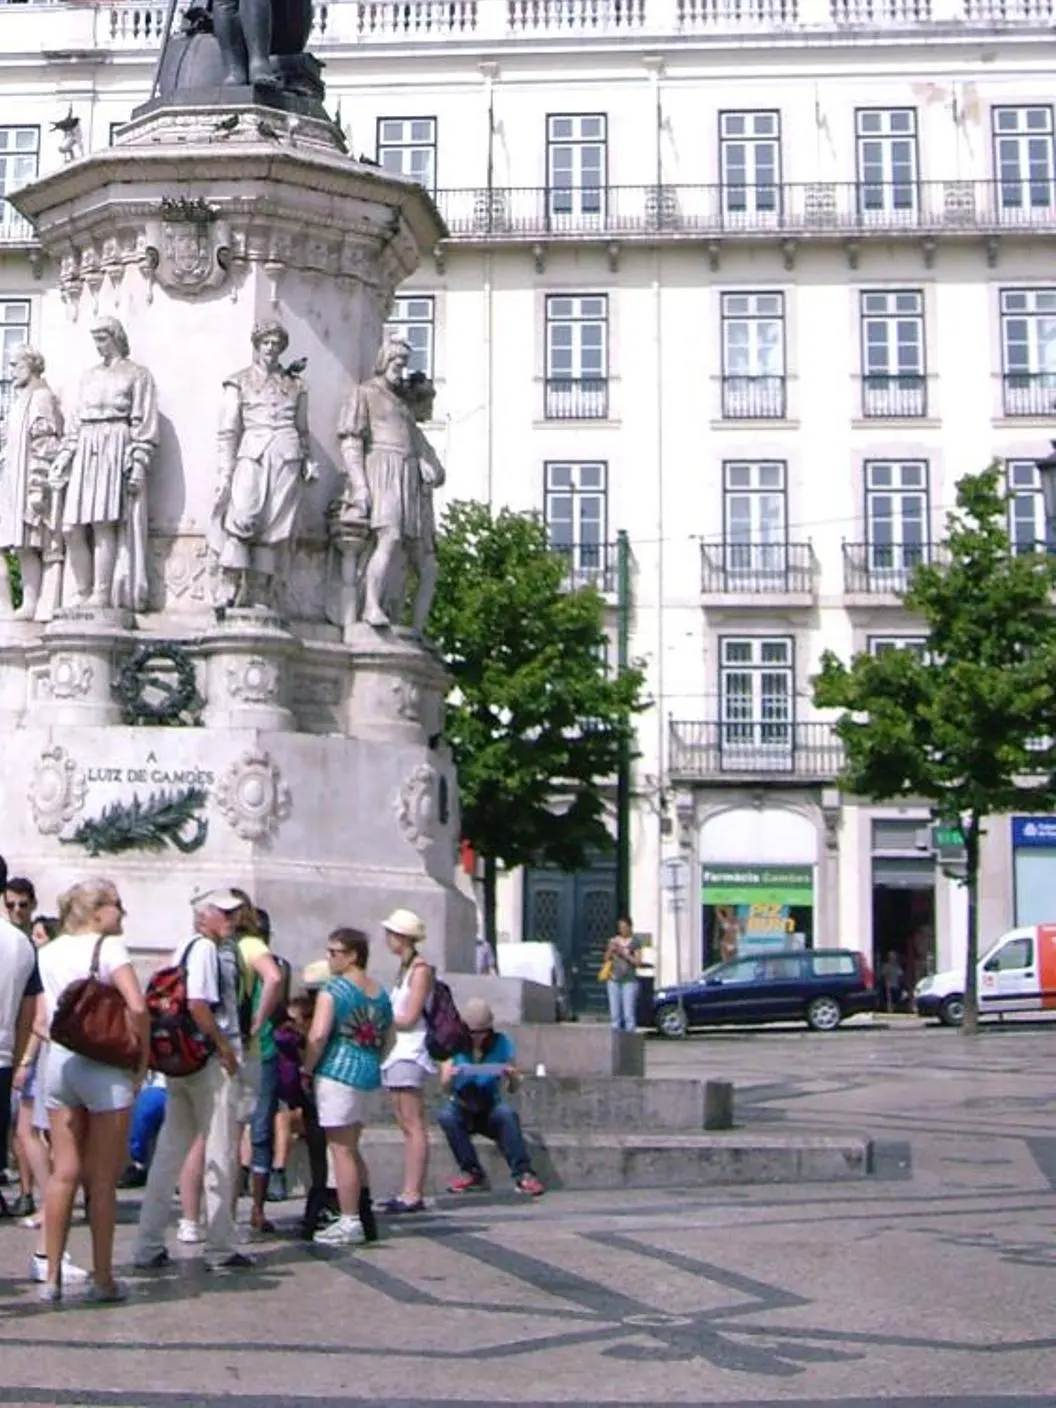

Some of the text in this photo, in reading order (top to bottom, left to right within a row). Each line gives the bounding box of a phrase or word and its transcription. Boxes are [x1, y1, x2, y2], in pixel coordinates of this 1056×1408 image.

[146, 750, 157, 764] A
[87, 768, 123, 782] LUIZ
[127, 769, 147, 783] DE
